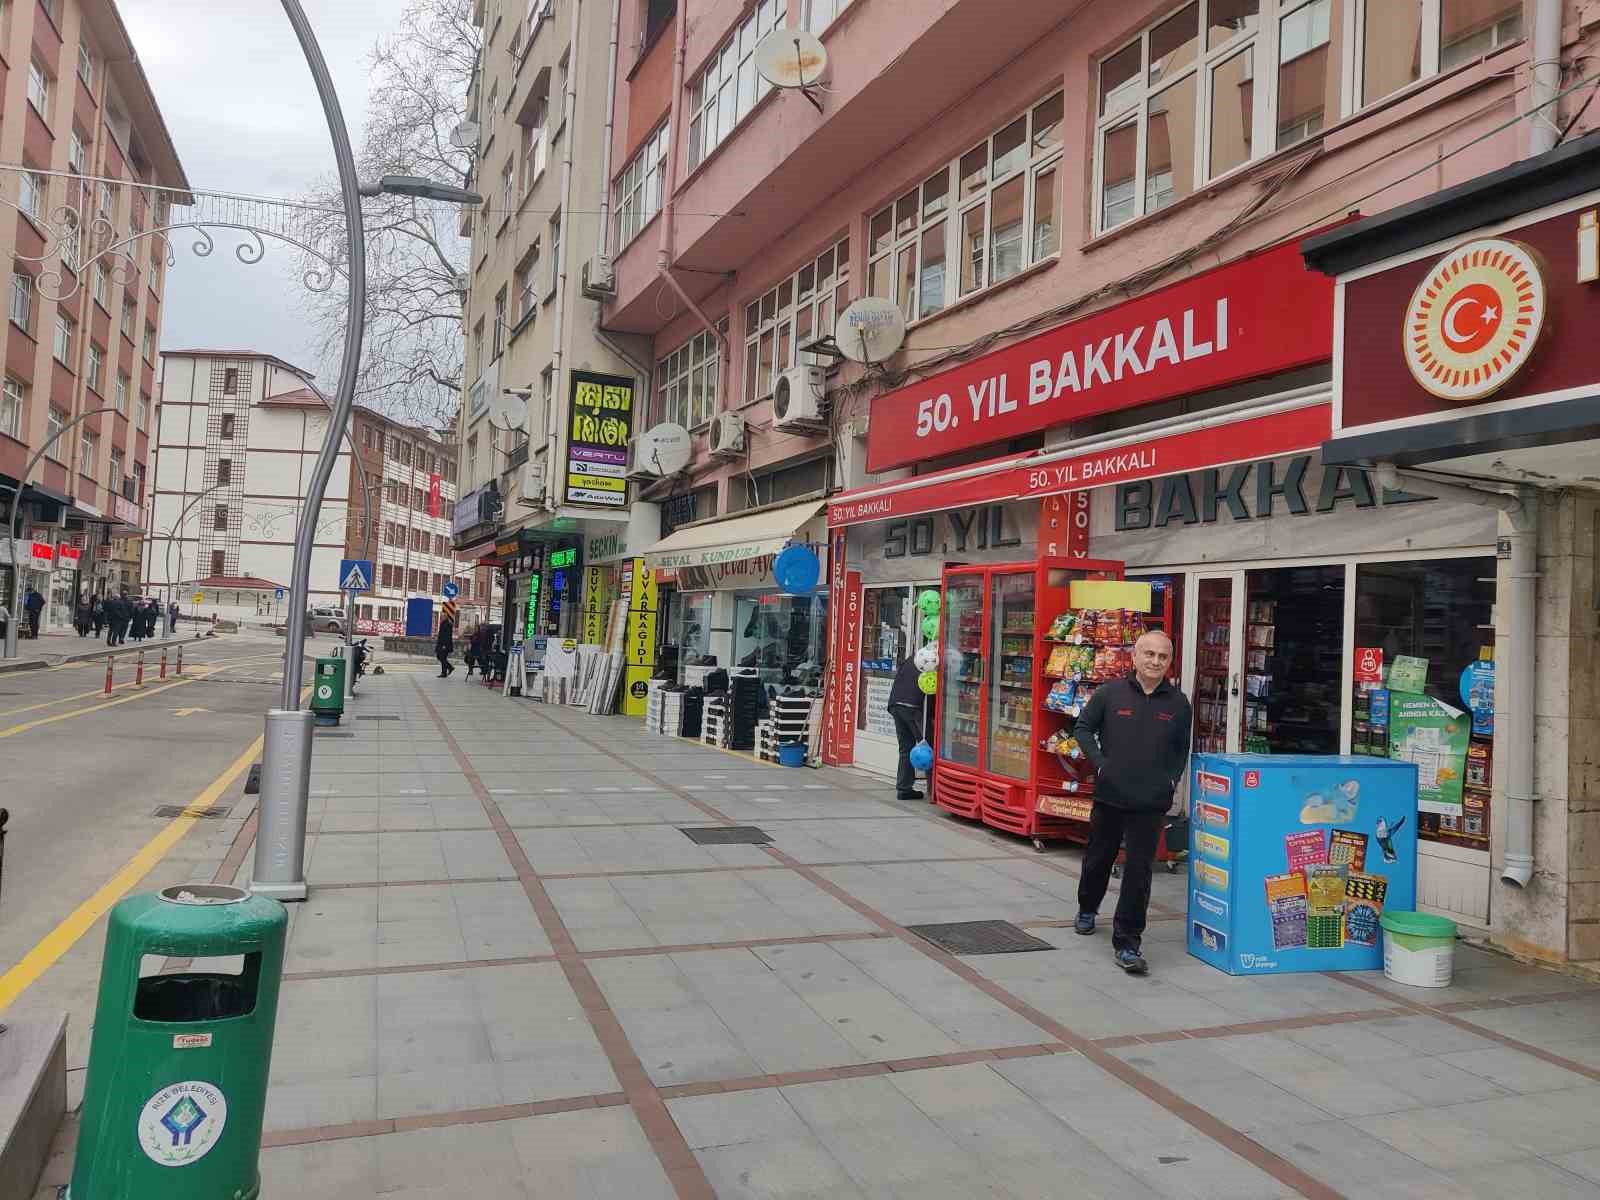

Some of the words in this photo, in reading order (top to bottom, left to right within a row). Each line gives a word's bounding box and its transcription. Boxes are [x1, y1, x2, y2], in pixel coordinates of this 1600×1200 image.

[915, 393, 959, 437] 50.
[968, 373, 1018, 422] YIL
[1028, 298, 1229, 405] BAKKALI
[1030, 470, 1051, 489] 50.
[1056, 465, 1078, 484] YIL
[1082, 447, 1157, 480] BAKKALI
[857, 497, 892, 517] BAKKALI
[944, 505, 1022, 552] YIL
